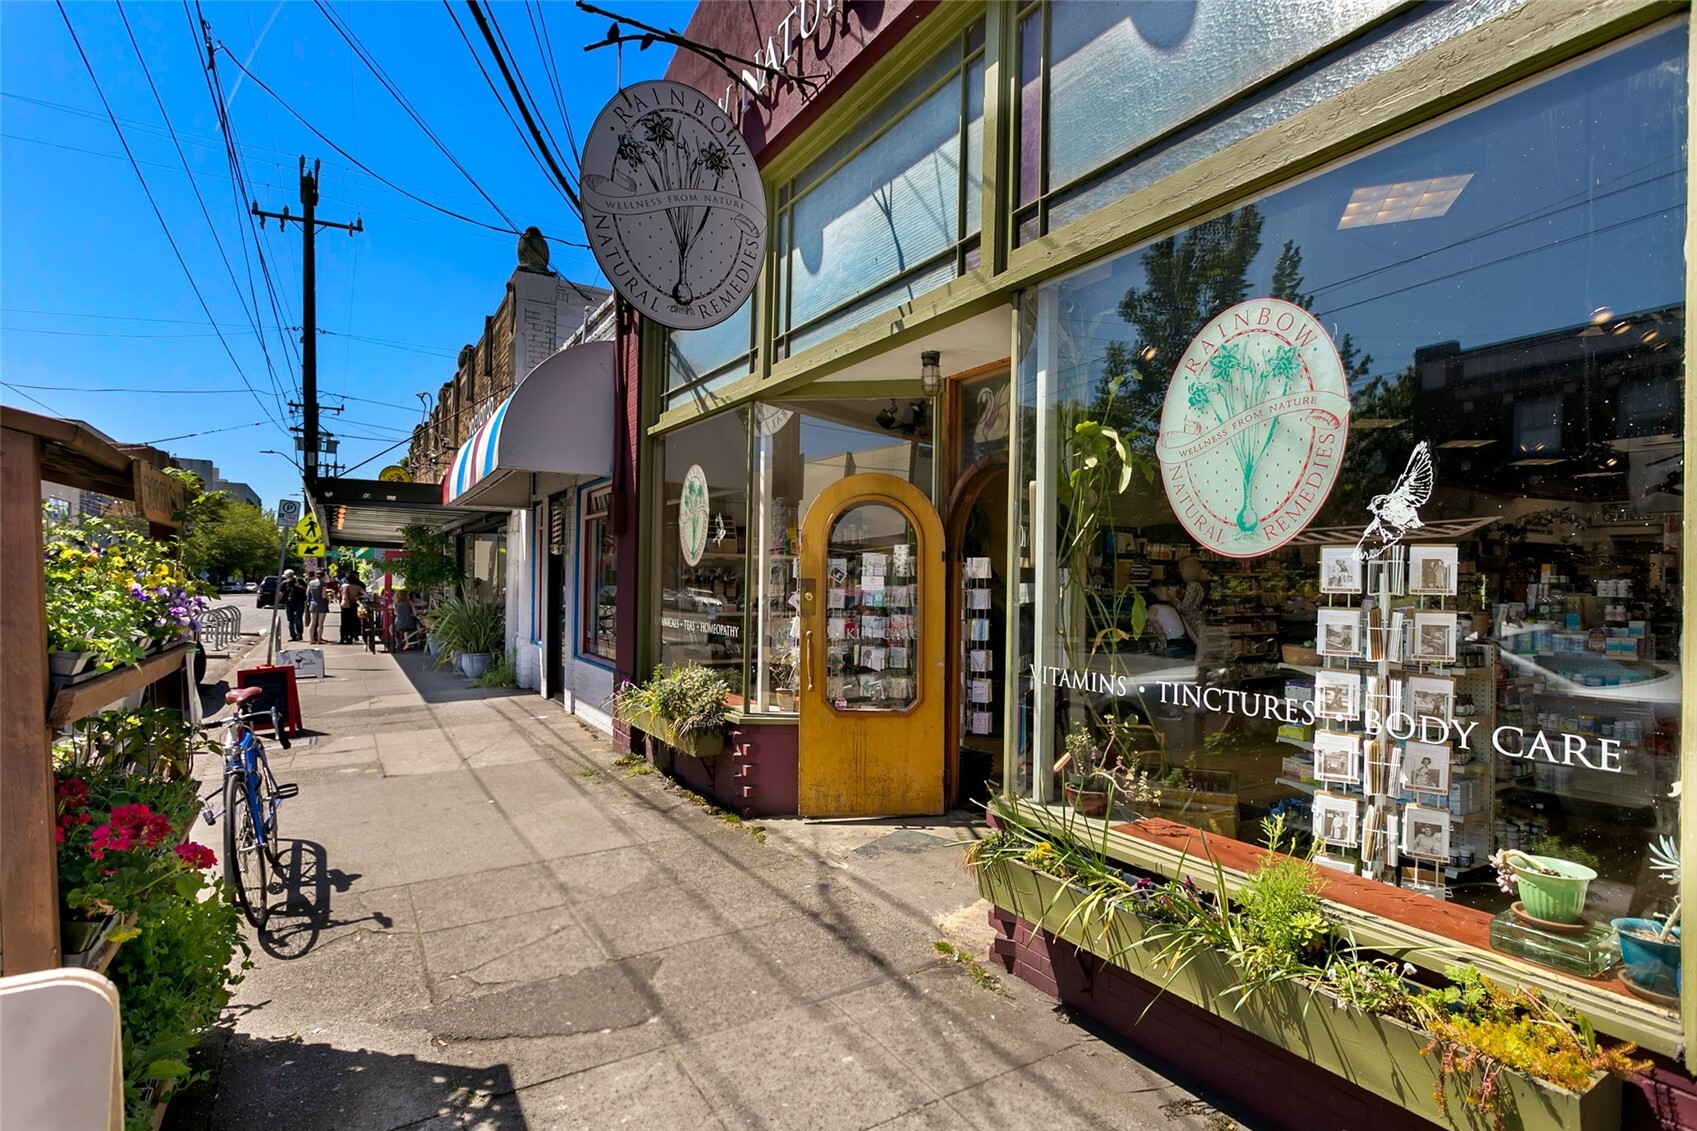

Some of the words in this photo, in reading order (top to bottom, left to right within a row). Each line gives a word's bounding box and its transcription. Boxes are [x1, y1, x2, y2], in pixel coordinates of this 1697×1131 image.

[741, 0, 836, 114] NATU
[613, 88, 746, 158] RAINBOW
[605, 199, 662, 210] WELLNESS
[667, 194, 698, 203] FROM
[704, 195, 745, 210] NATURE
[592, 214, 660, 313] NATURAL
[699, 239, 759, 319] REMEDIES
[1184, 307, 1318, 374] RAINBOW
[1179, 429, 1228, 458] WELLNESS
[1231, 410, 1264, 430] FROM
[1268, 396, 1318, 413] NATURE
[1169, 465, 1225, 545] NATURAL
[1262, 432, 1336, 541] REMEDIES
[683, 619, 696, 632] TEAS
[700, 621, 740, 638] HOMEOPATHY
[1029, 663, 1127, 697] VITAMINS
[1156, 681, 1316, 725] TINCTURES
[1363, 708, 1480, 750] BODY
[1491, 725, 1622, 773] CARE
